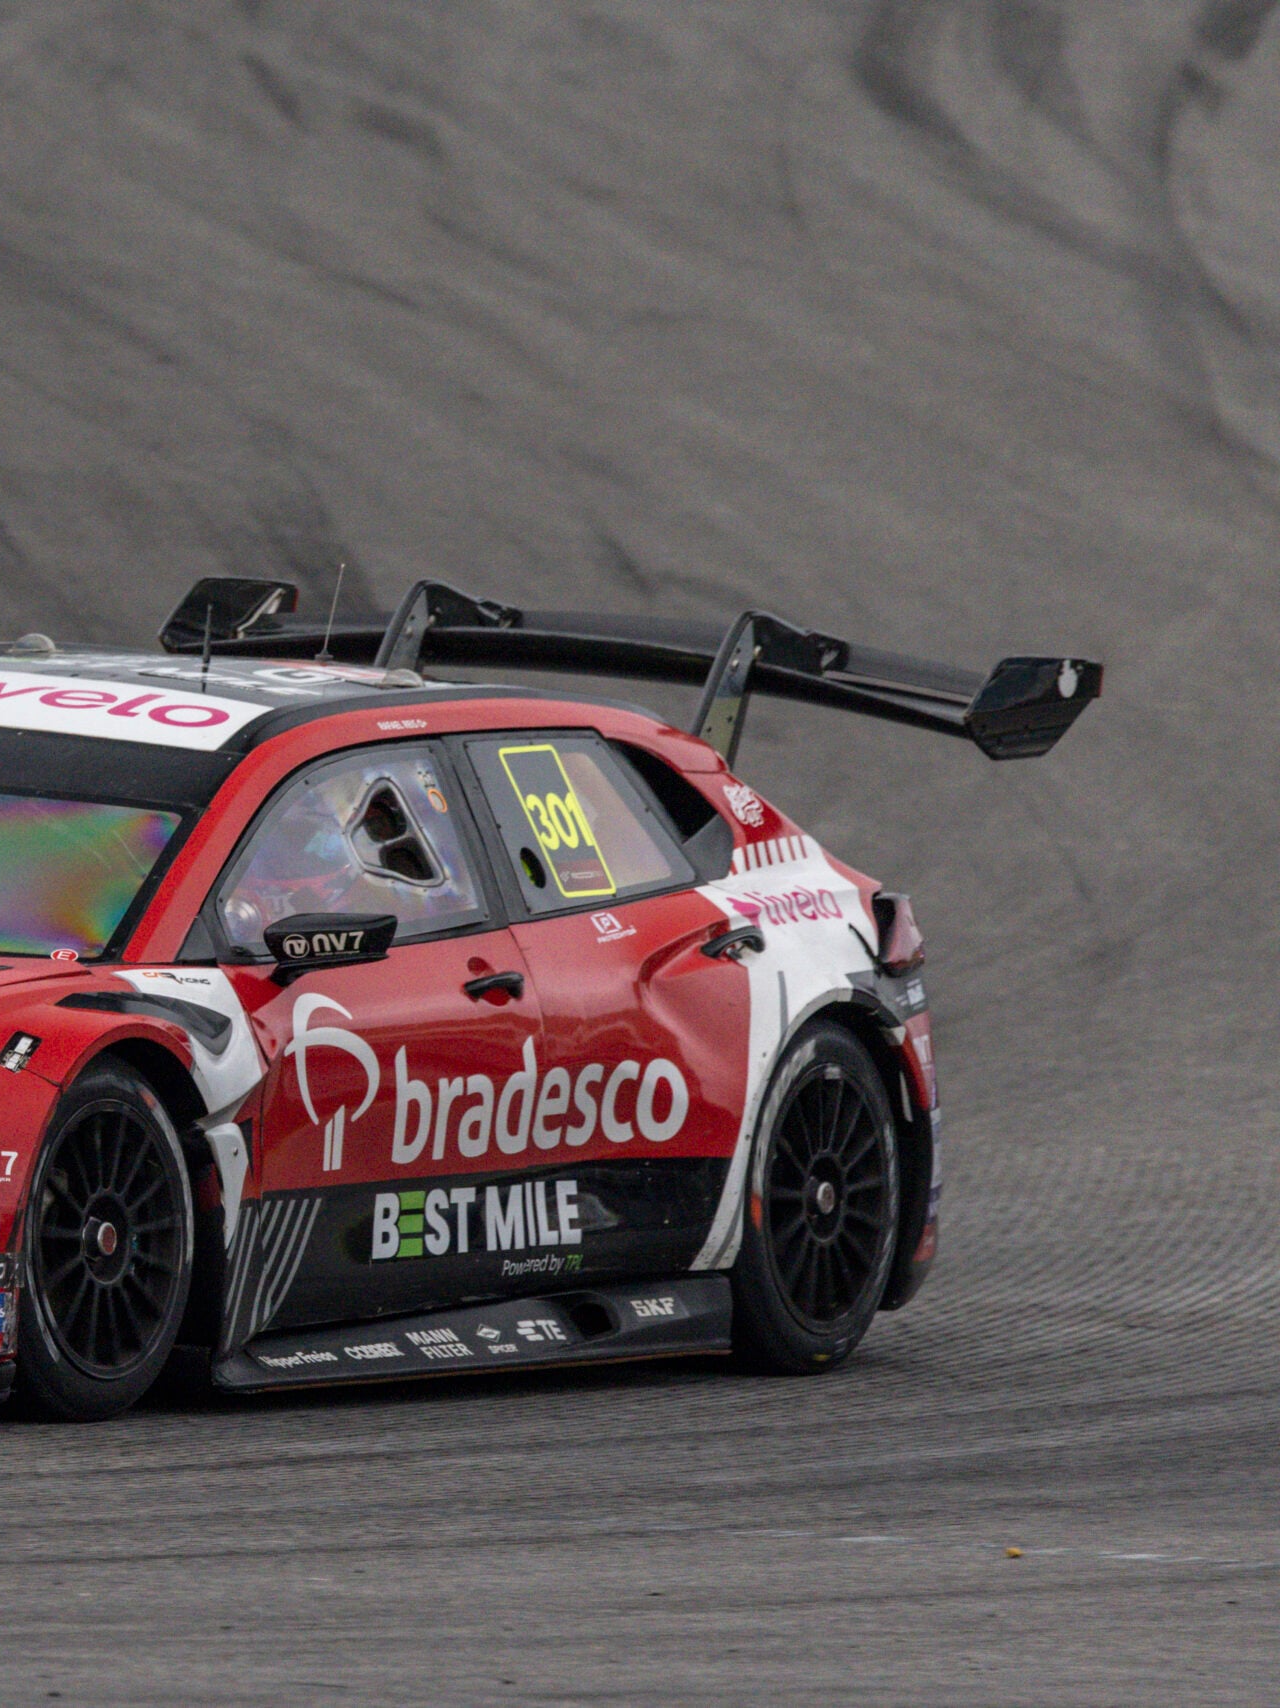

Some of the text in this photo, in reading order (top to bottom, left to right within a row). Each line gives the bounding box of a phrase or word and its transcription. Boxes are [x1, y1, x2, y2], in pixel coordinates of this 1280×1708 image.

[525, 792, 596, 851] 301
[743, 884, 844, 927] livelo
[391, 1035, 690, 1165] bradesco
[371, 1179, 583, 1260] BEST MILE
[548, 1253, 565, 1276] by
[629, 1296, 675, 1318] SKF
[405, 1327, 460, 1347] MANN
[420, 1342, 474, 1361] FILTER
